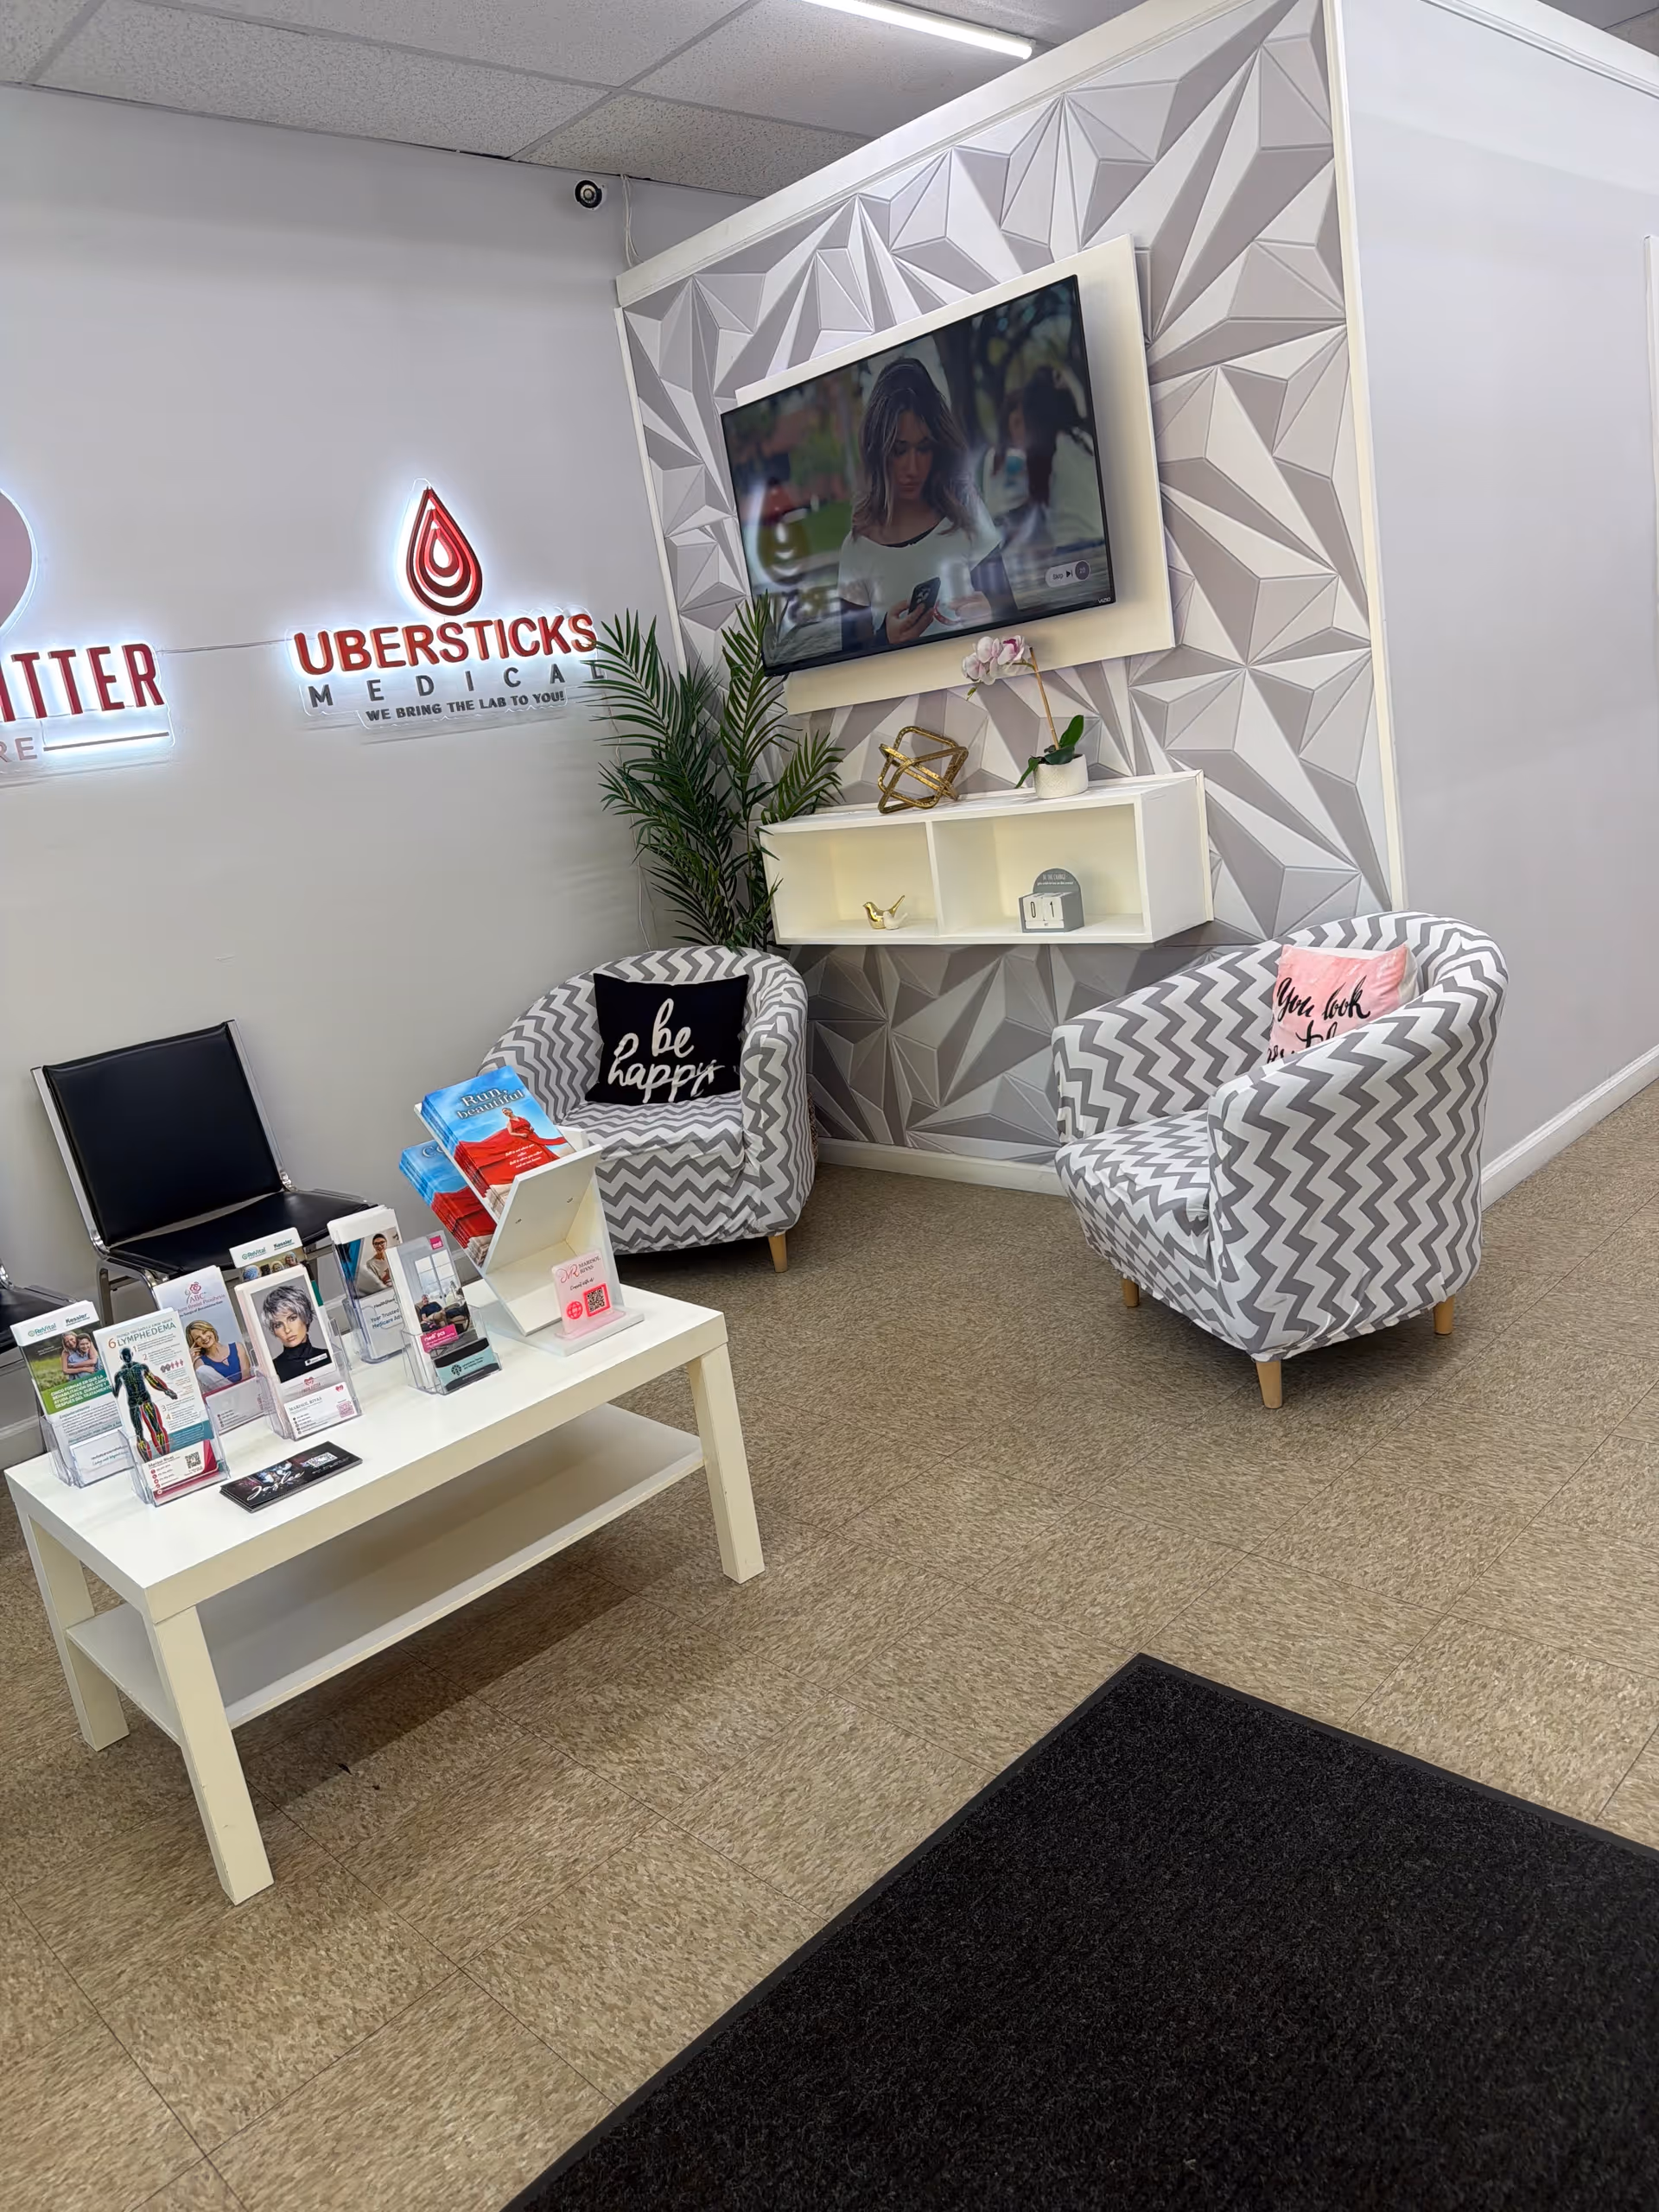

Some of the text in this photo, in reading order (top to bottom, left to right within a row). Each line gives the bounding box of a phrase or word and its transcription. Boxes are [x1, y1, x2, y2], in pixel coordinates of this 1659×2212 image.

[294, 613, 597, 675] UBERSTICKS
[308, 661, 604, 708] MEDICAL
[366, 690, 565, 721] WE BRING THE LAB TO YOU!
[1030, 901, 1036, 918] 0
[1276, 975, 1371, 1022] You look
[652, 998, 695, 1058] be
[607, 1033, 725, 1104] happy
[457, 1090, 524, 1120] beautiful
[461, 1088, 508, 1107] Run,
[66, 1313, 87, 1324] Kessler
[372, 1318, 393, 1330] Medicare
[382, 1308, 400, 1318] Trusted
[35, 1323, 57, 1335] ReVital
[117, 1322, 177, 1346] LYMPHEDEMA
[108, 1338, 117, 1348] 6
